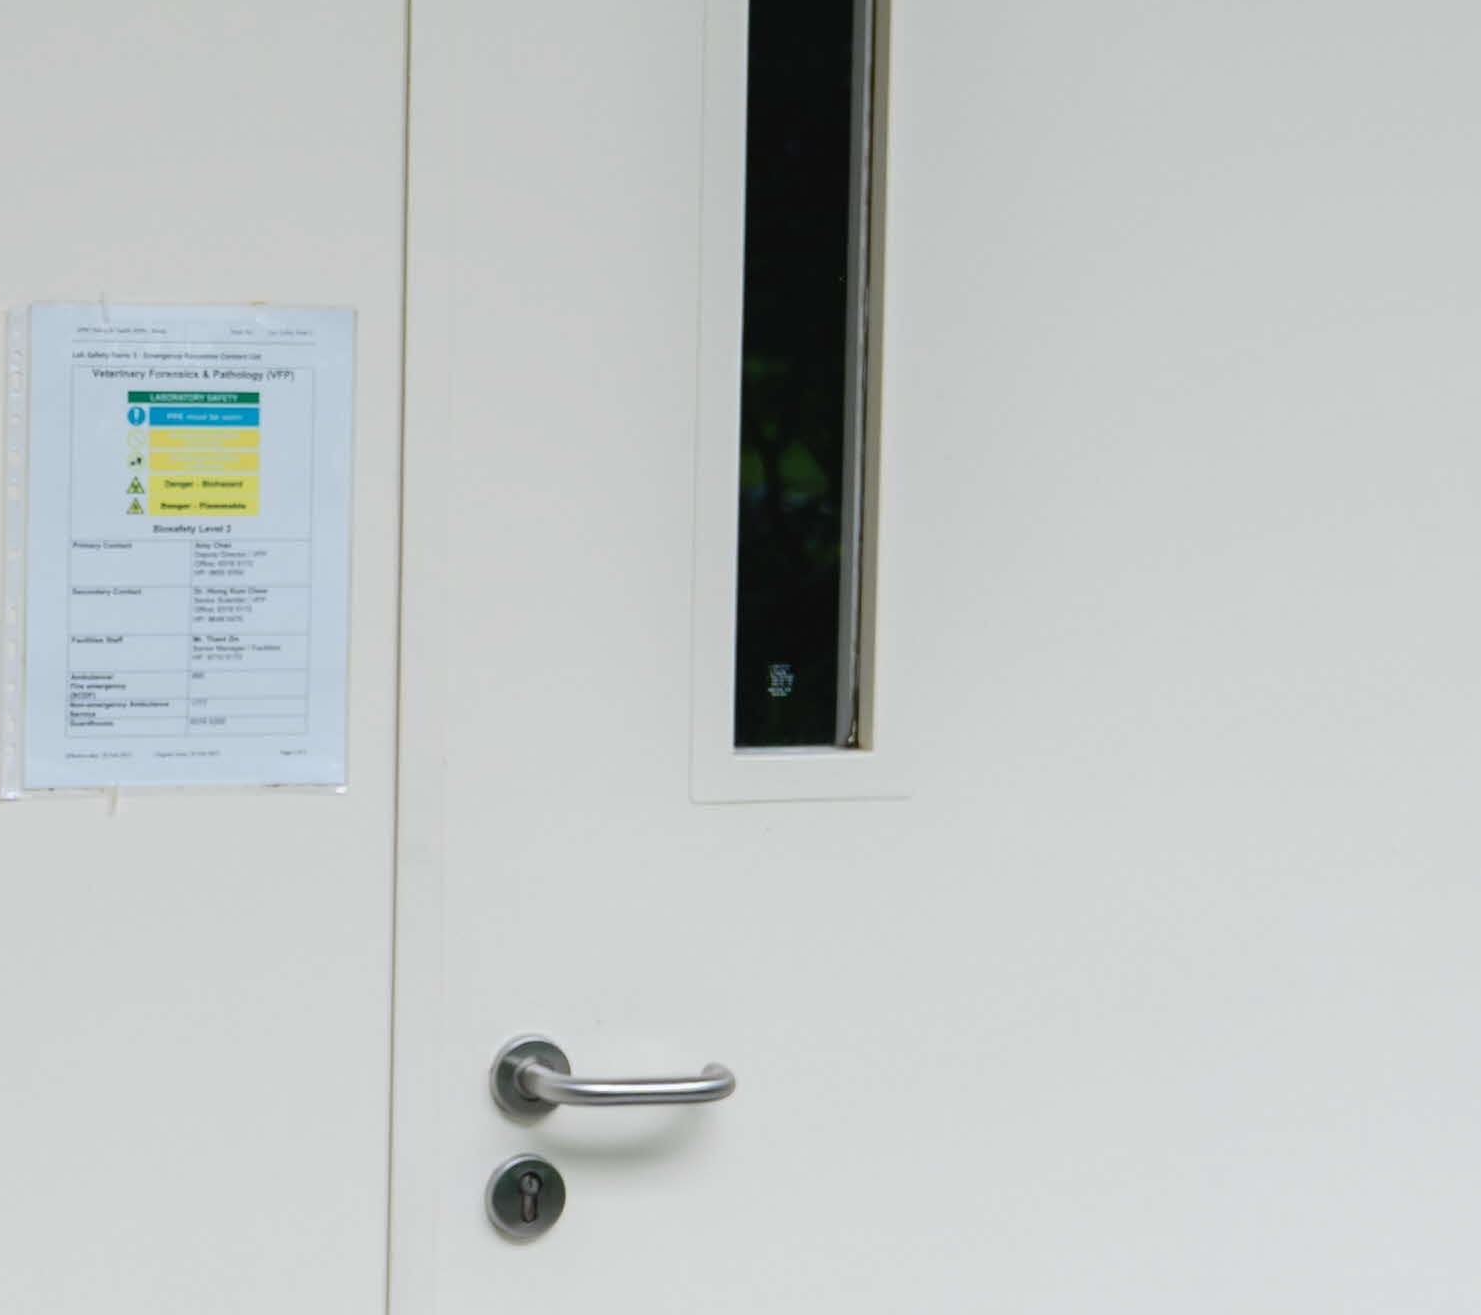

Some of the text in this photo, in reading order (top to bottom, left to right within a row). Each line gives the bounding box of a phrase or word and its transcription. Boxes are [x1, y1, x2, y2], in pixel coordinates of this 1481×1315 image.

[91, 369, 145, 381] Veterinary
[148, 369, 198, 380] Forensics
[203, 369, 210, 379] &
[213, 370, 263, 382] Pathology
[206, 394, 239, 403] SAFETY
[152, 524, 196, 535] Biosafety
[198, 524, 224, 533] Level
